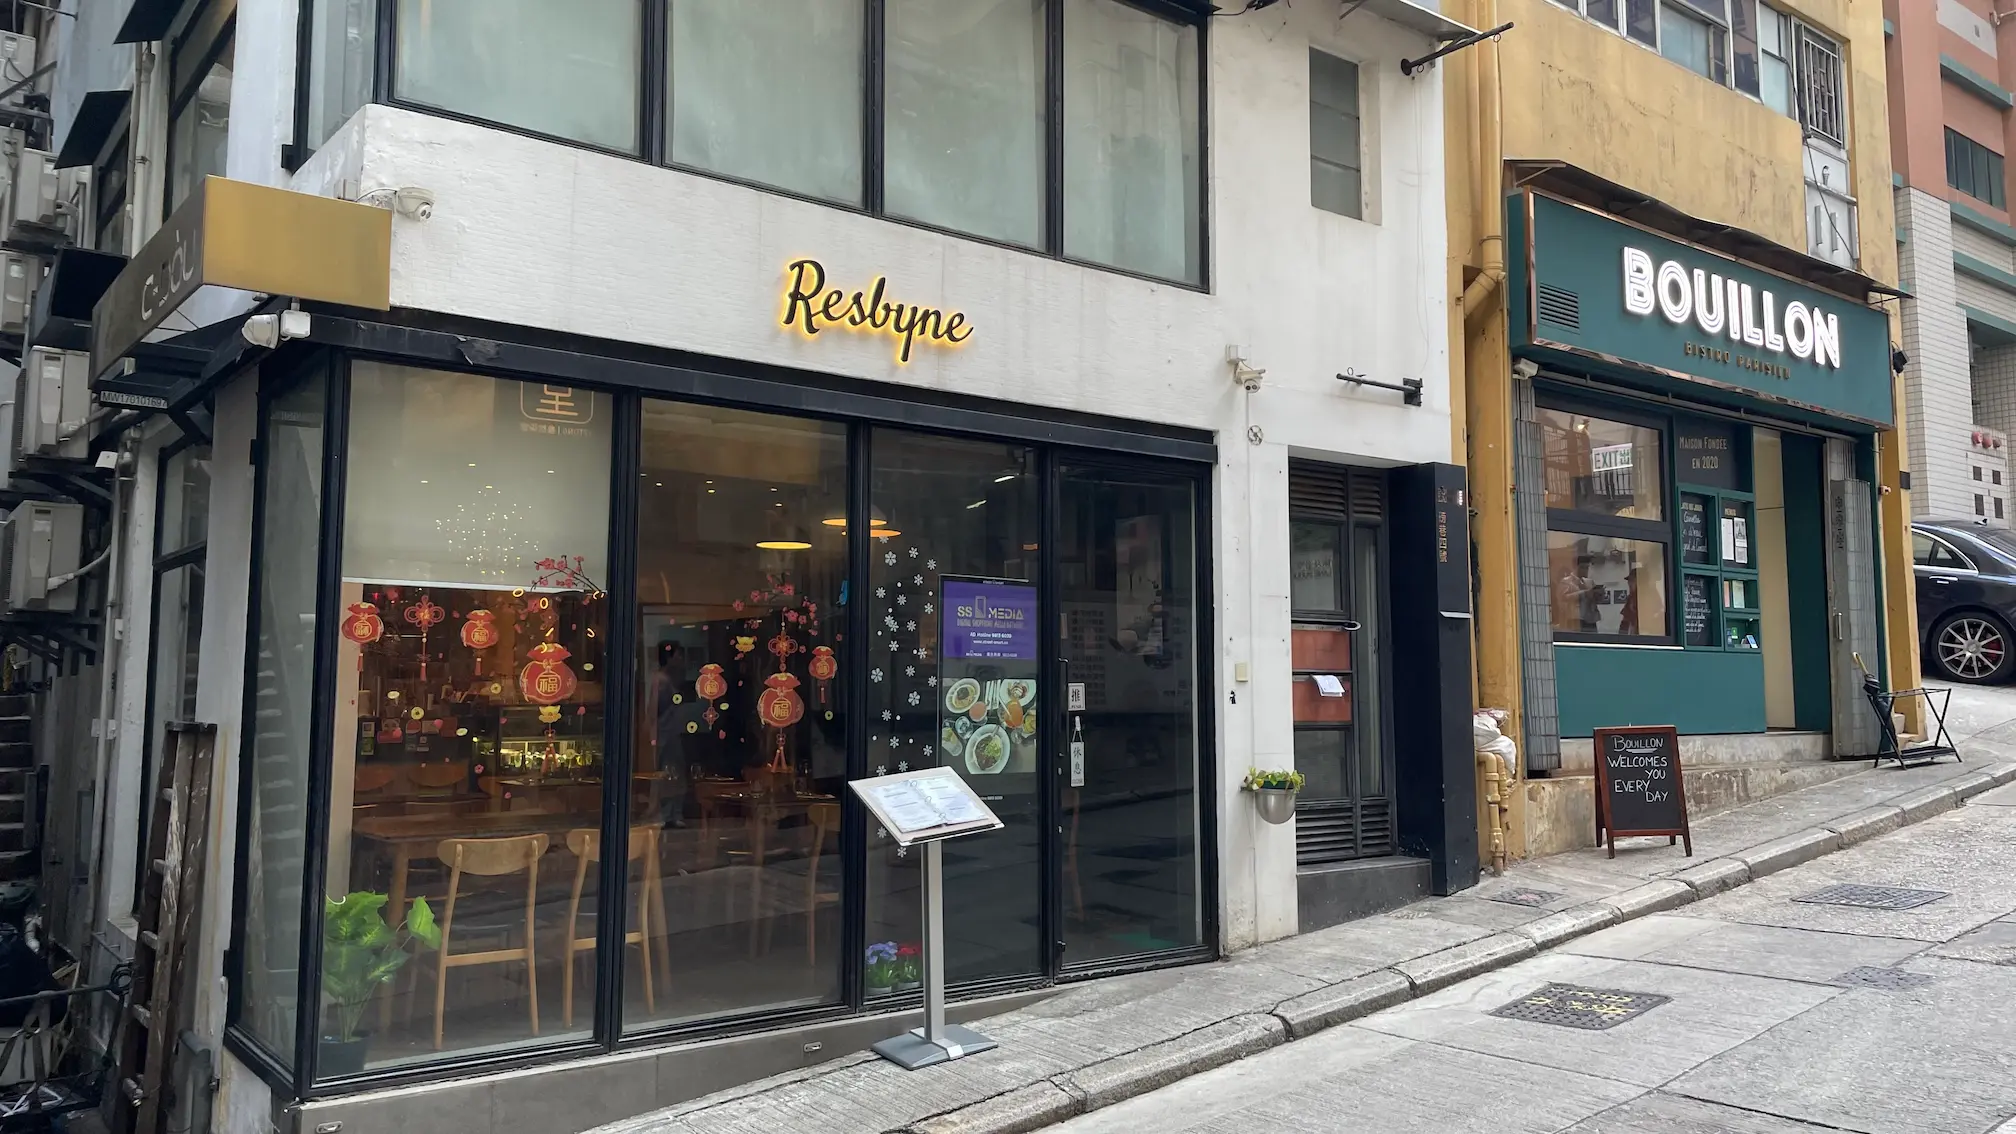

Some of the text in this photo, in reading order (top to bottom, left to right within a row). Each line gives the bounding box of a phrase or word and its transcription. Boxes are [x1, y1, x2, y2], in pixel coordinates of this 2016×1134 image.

[782, 259, 974, 362] Resbyne
[1623, 246, 1841, 369] BOUILLON
[1684, 341, 1731, 364] BISTRO
[1594, 450, 1619, 469] EXIT
[1702, 455, 1719, 469] 2020
[957, 606, 1024, 620] SS MEDIA
[539, 674, 558, 693] 福
[1071, 688, 1081, 702] 推
[773, 700, 789, 717] 福
[1073, 746, 1082, 775] 休息
[1607, 755, 1668, 768] WELCOMES
[1645, 768, 1666, 780] YOU
[1614, 779, 1651, 793] EVERY
[1645, 791, 1669, 803] DAY
